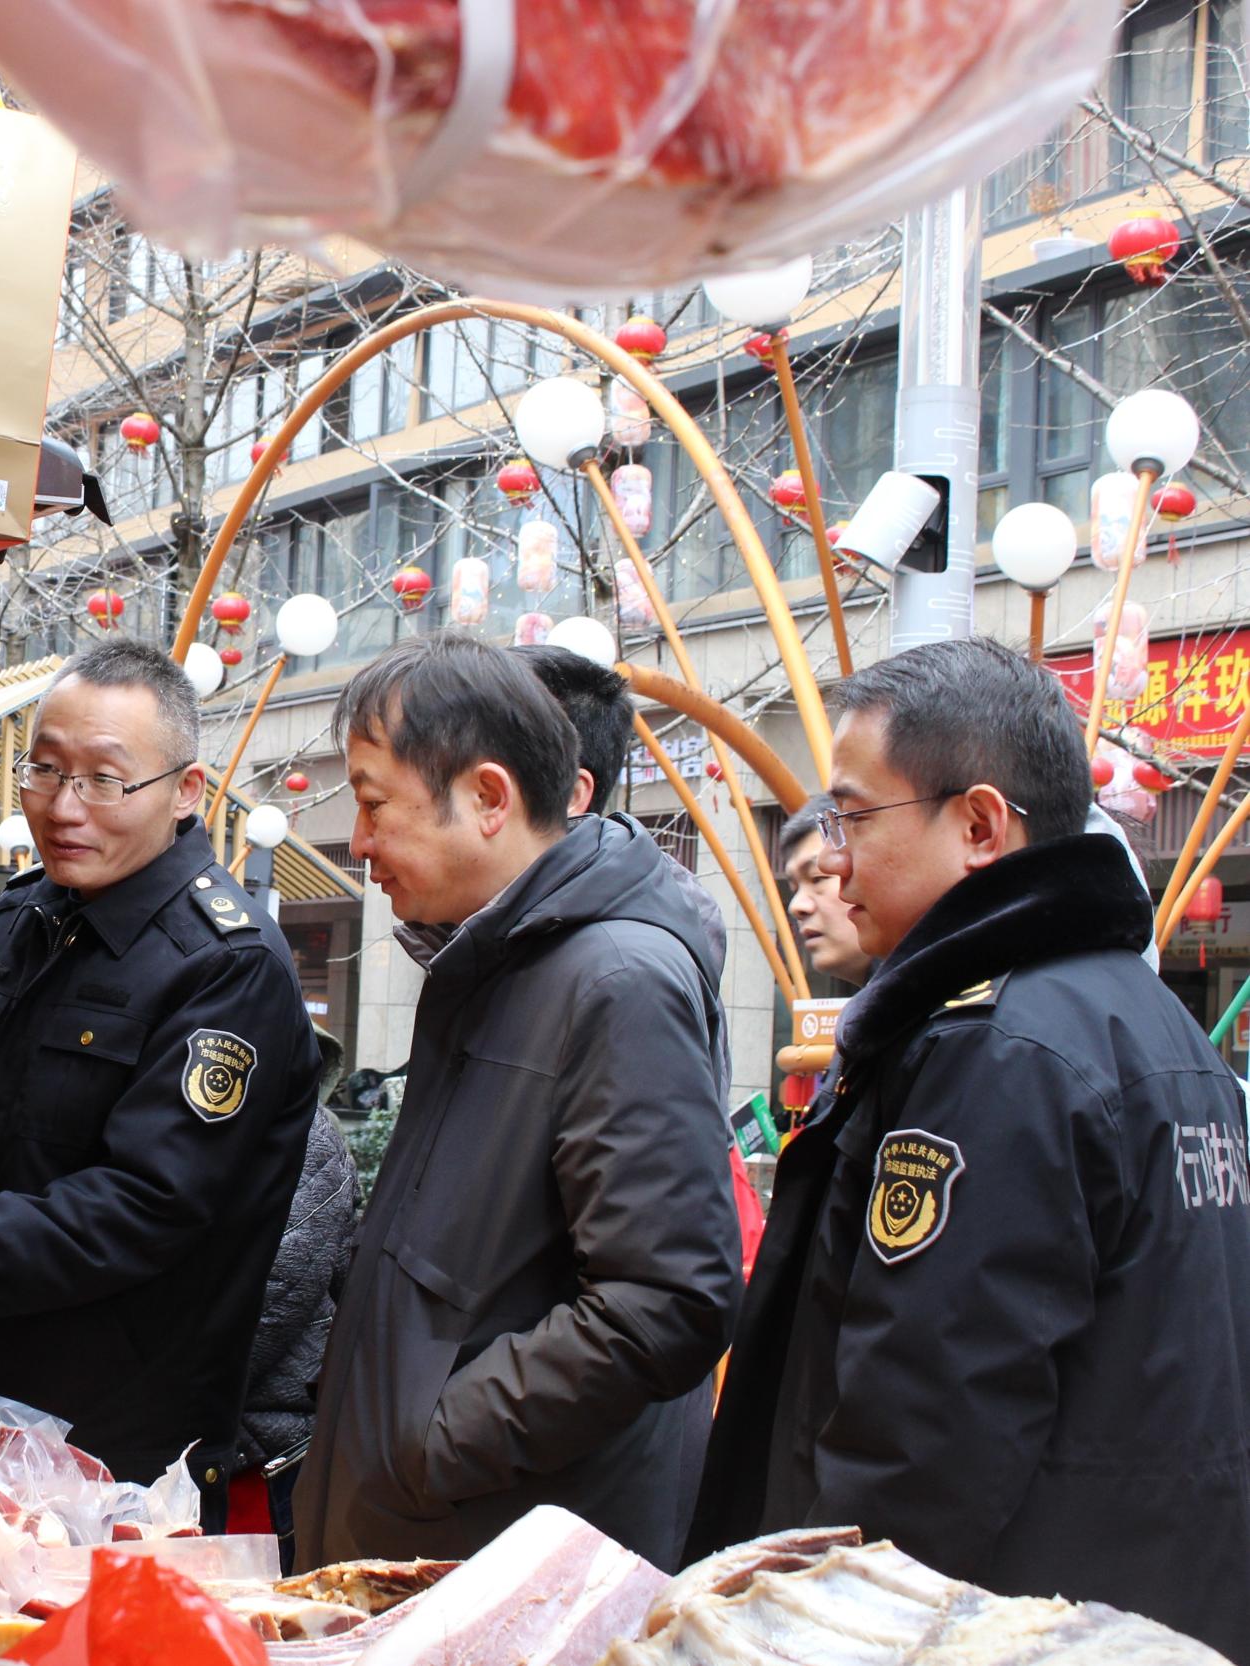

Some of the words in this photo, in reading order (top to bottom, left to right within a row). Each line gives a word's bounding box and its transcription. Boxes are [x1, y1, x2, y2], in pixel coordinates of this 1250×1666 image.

[197, 1037, 252, 1066] 中华人民共和国
[883, 1141, 951, 1169] 中华人民共和国
